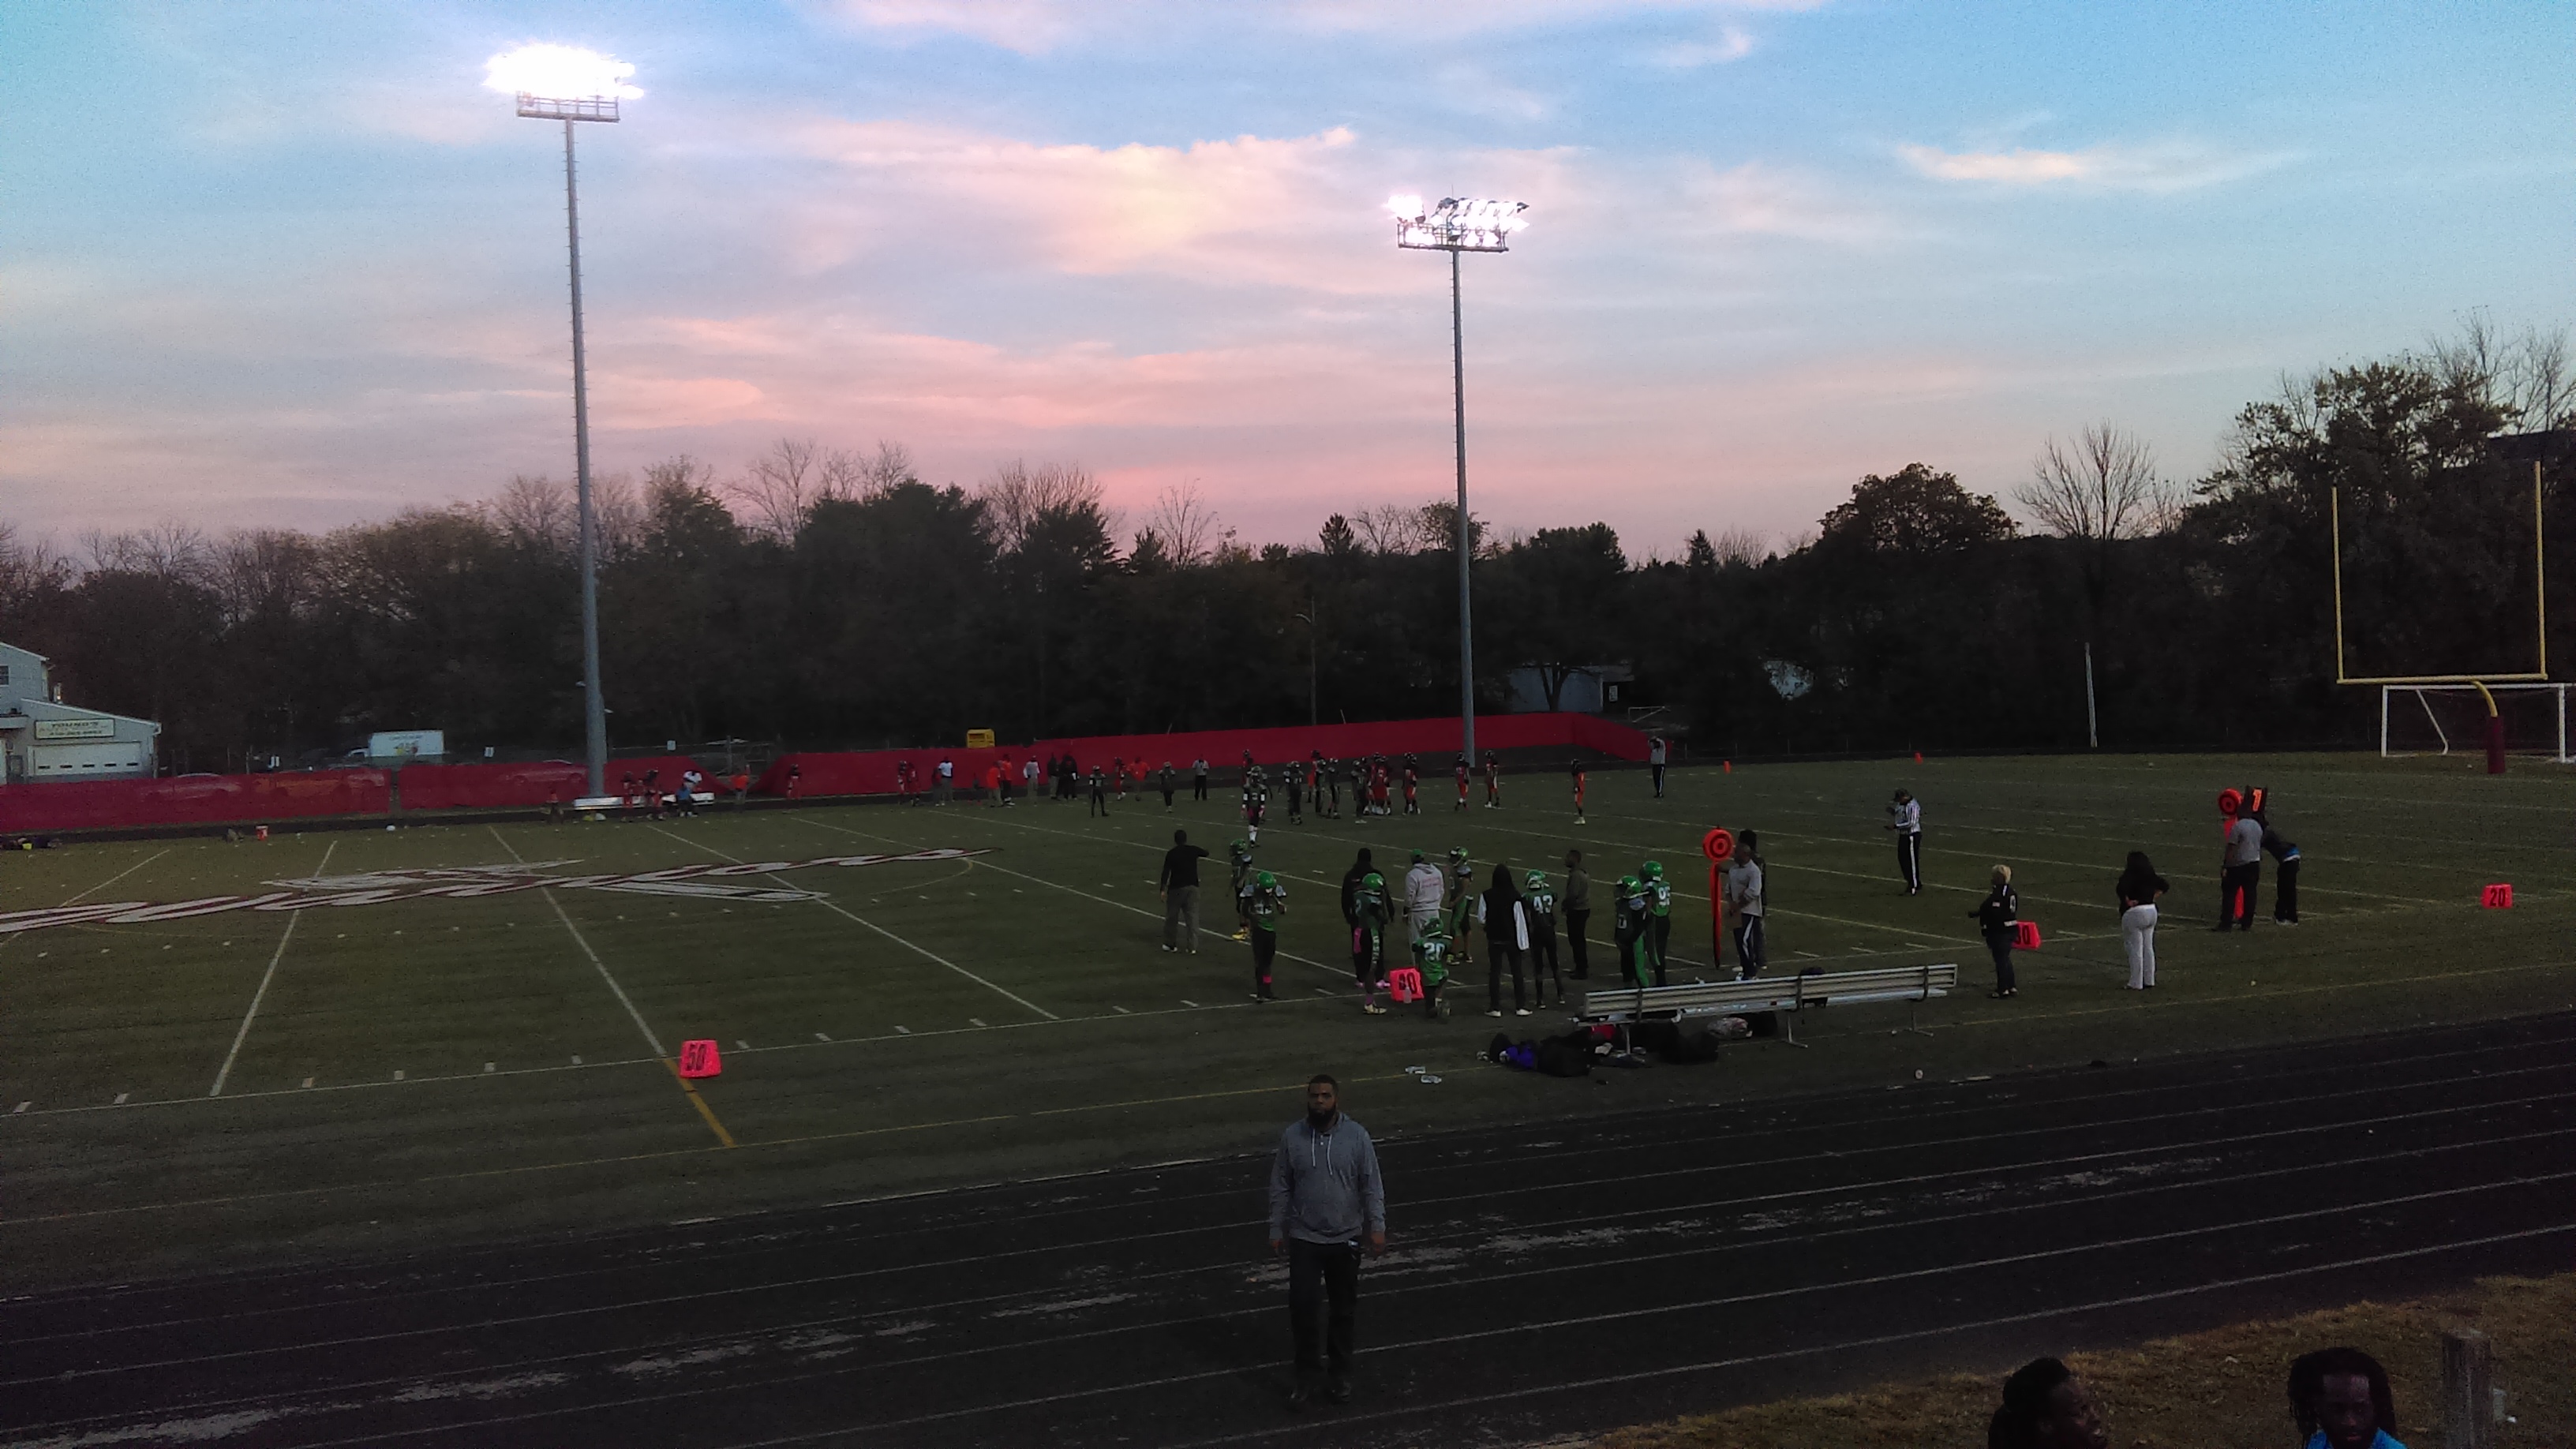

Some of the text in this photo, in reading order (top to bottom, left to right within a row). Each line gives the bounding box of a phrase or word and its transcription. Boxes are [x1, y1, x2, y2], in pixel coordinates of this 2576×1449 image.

[1533, 894, 1553, 914] 43
[2489, 888, 2507, 907] 20
[1423, 942, 1445, 962] 20
[685, 1043, 707, 1071] 50
